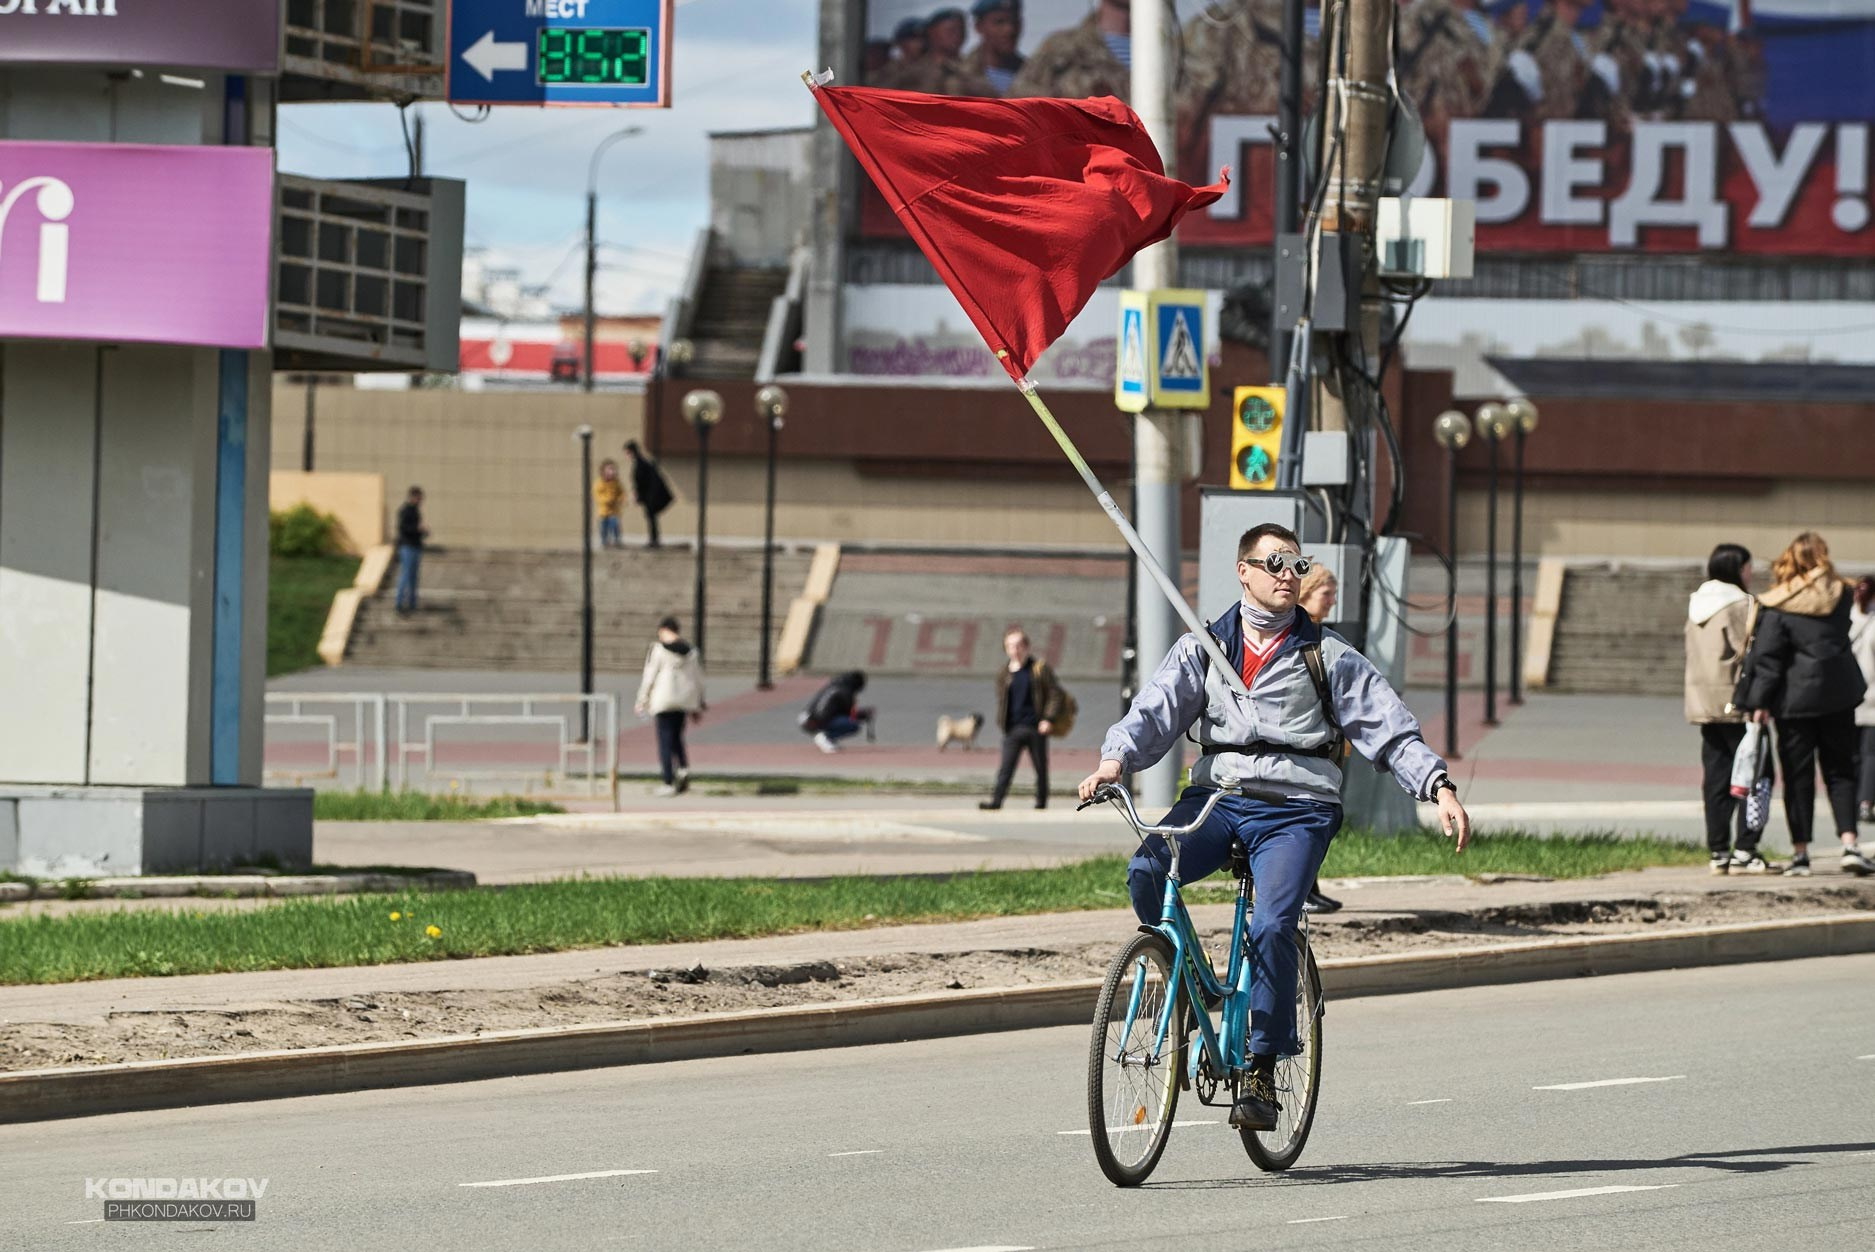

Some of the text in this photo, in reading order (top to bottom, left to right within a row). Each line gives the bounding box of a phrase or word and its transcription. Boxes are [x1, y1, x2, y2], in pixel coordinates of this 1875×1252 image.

[525, 0, 590, 18] МЕСТ
[540, 29, 646, 83] 852
[1208, 115, 1869, 247] ПБЕДУ!
